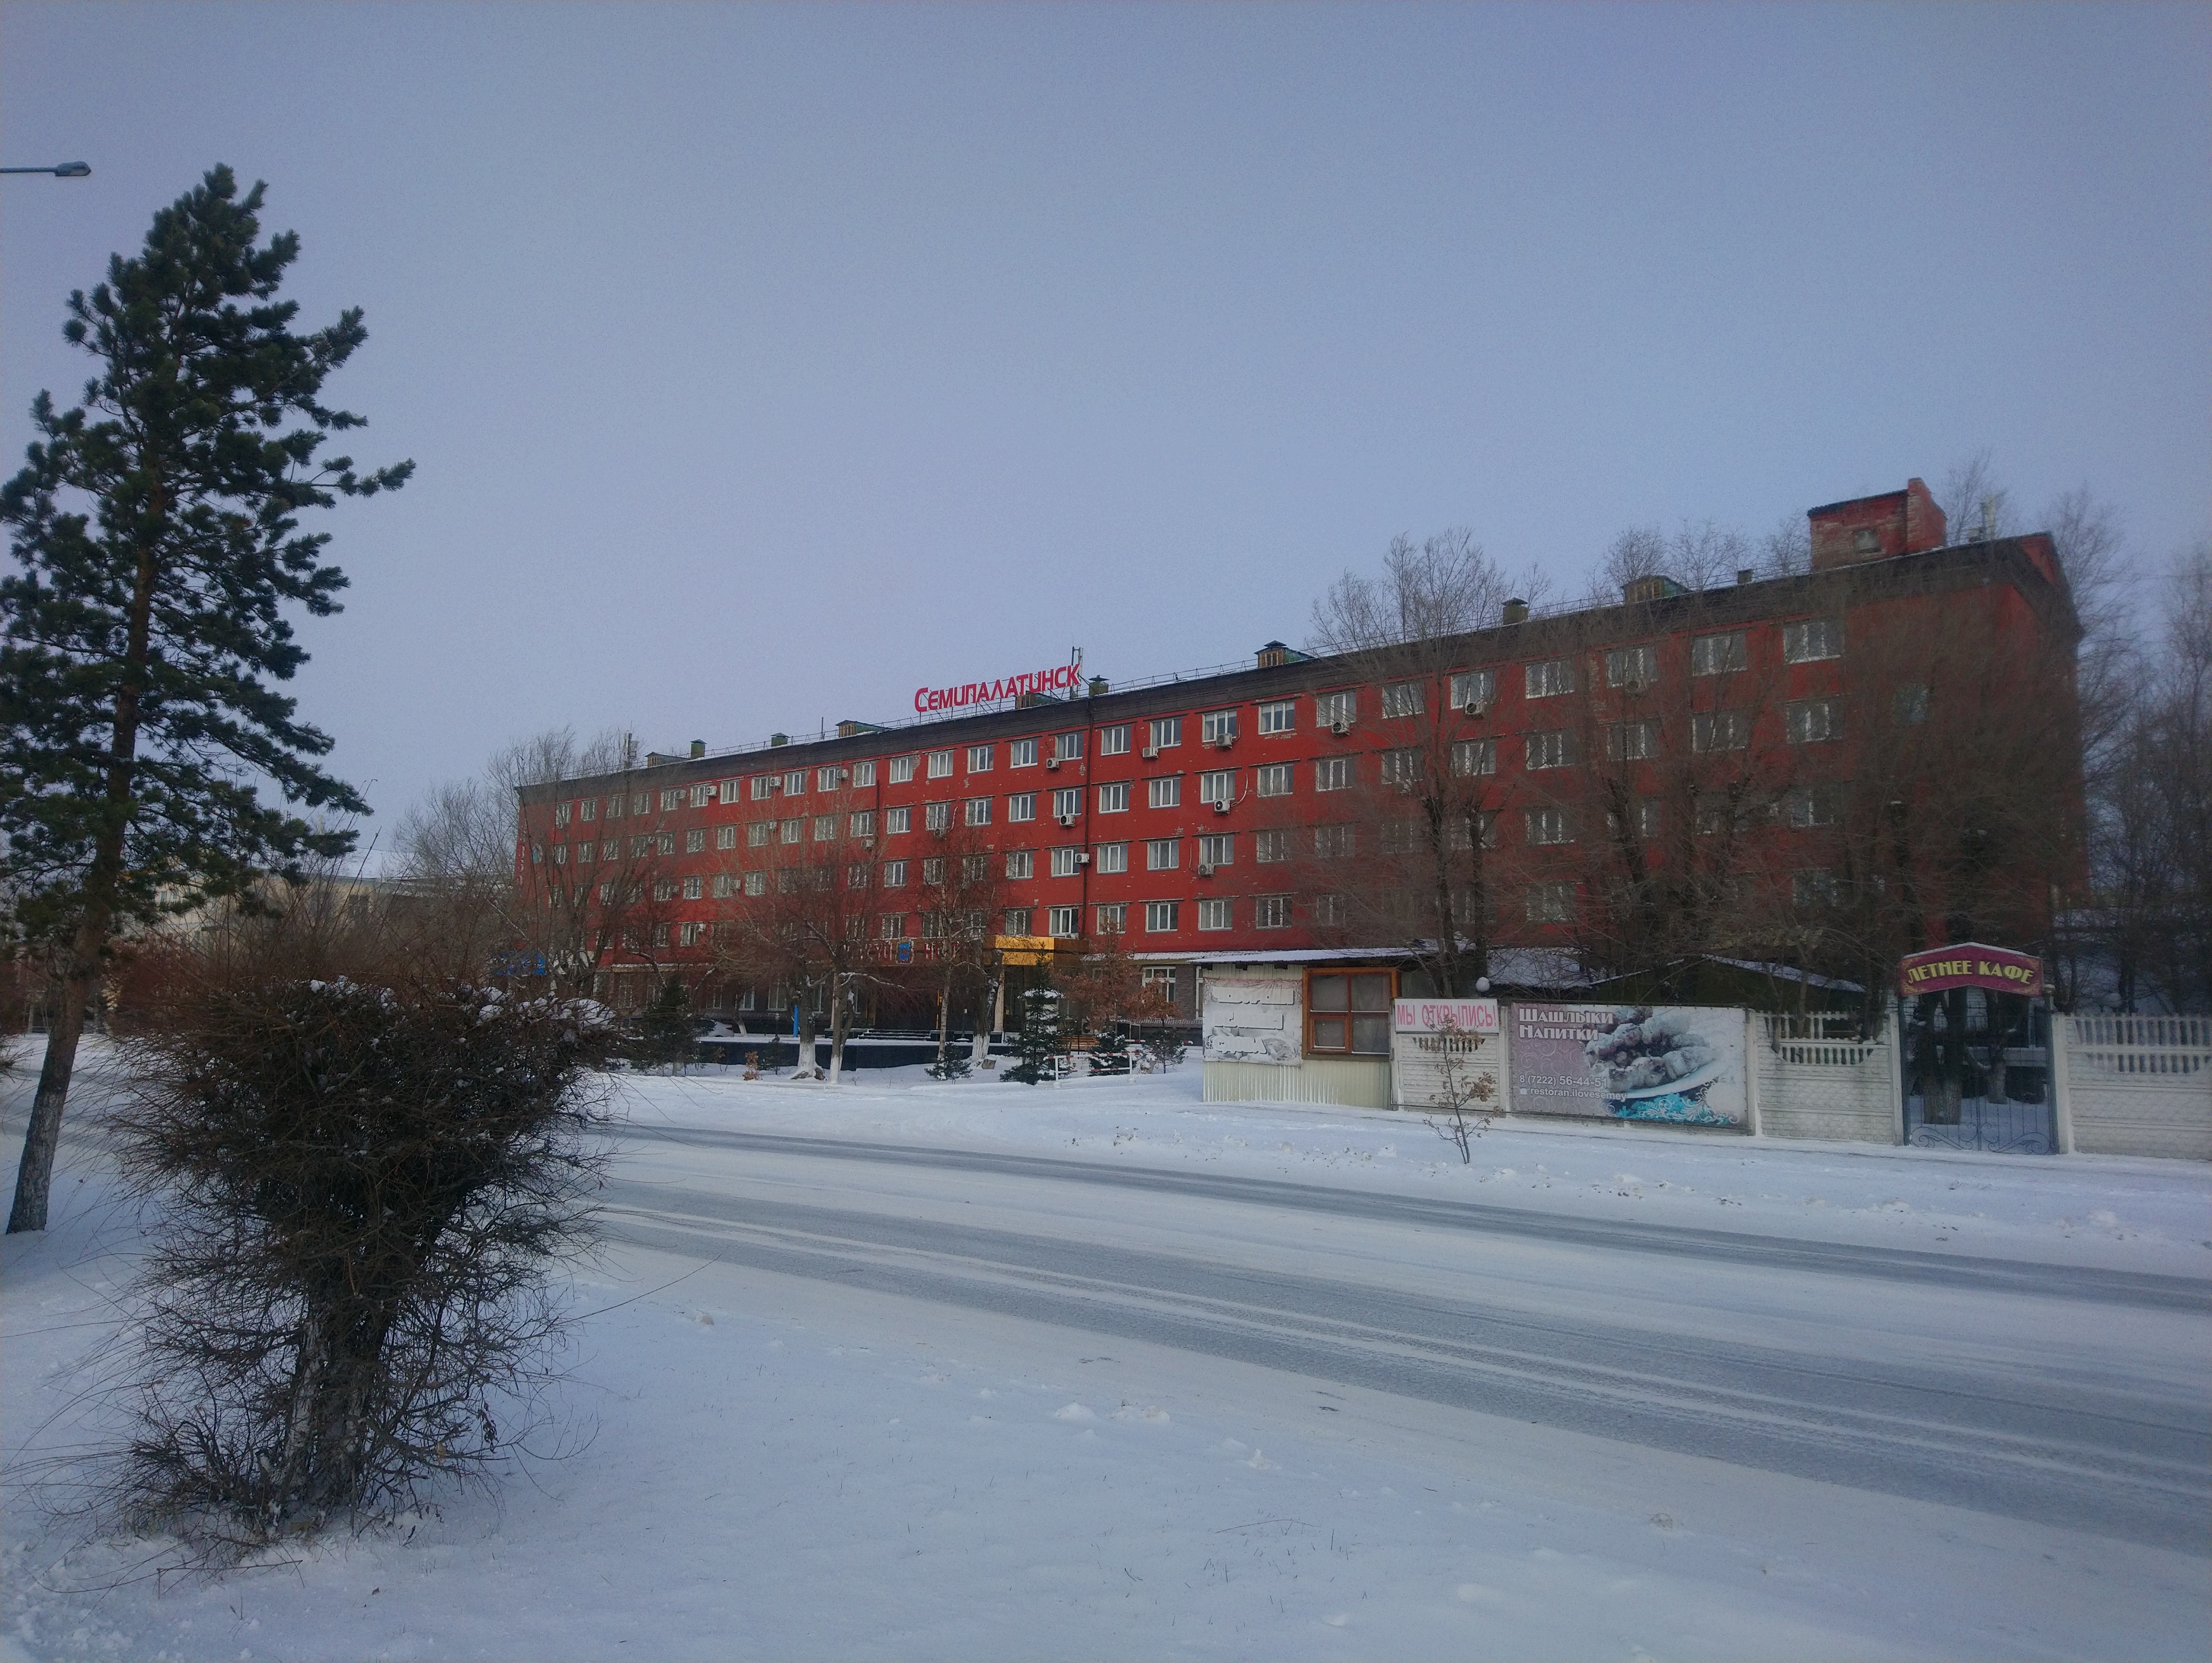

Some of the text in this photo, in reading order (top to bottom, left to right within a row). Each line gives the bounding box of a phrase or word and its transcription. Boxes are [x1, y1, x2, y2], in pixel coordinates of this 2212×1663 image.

[1908, 960, 2034, 984] ЛЕТНЕЕ КАФЕ
[1397, 1005, 1497, 1027] МЫ ОТКРЫЛИСЬ!
[1520, 1075, 1609, 1088] 8 (7222) 56-44-51
[1530, 1087, 1626, 1102] restoran.ilovesemey
